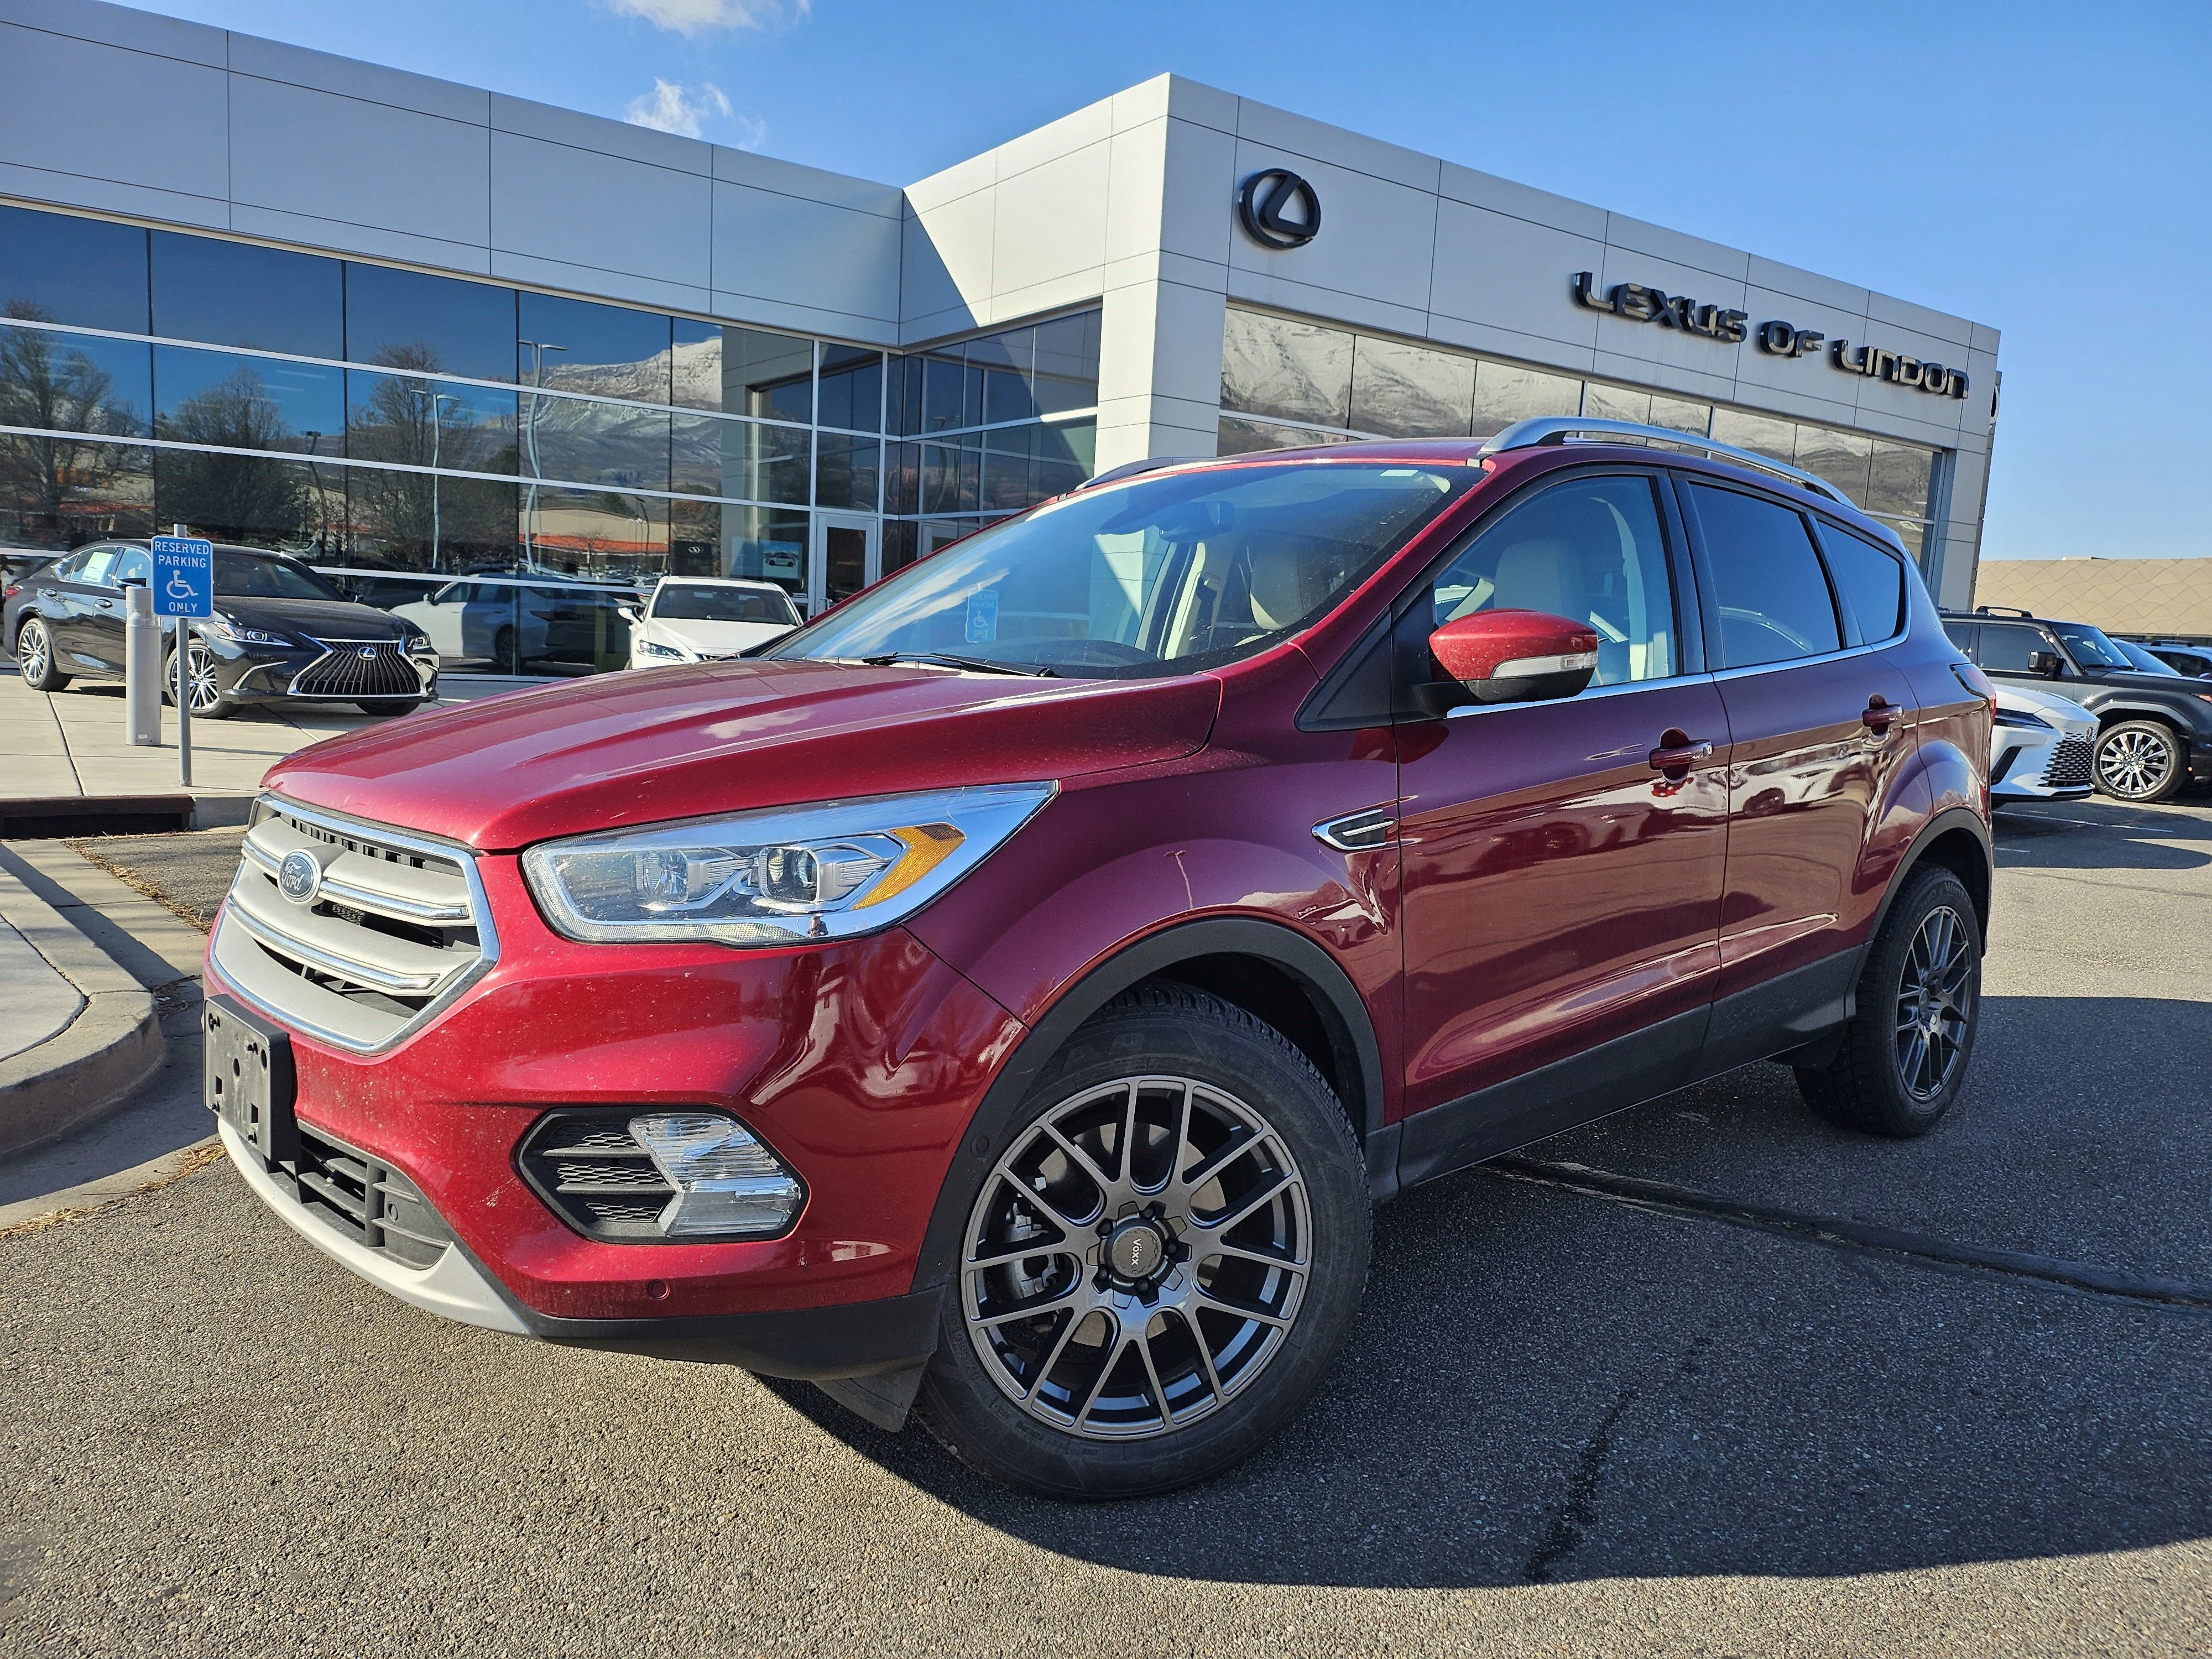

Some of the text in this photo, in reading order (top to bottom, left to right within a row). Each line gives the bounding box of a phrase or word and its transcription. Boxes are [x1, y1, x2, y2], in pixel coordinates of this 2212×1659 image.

[1575, 272, 1969, 399] LEXUS OF LINDON
[155, 541, 210, 555] RESERVED
[158, 555, 206, 568] PARKING
[169, 602, 197, 613] ONLY
[281, 861, 305, 891] Ford
